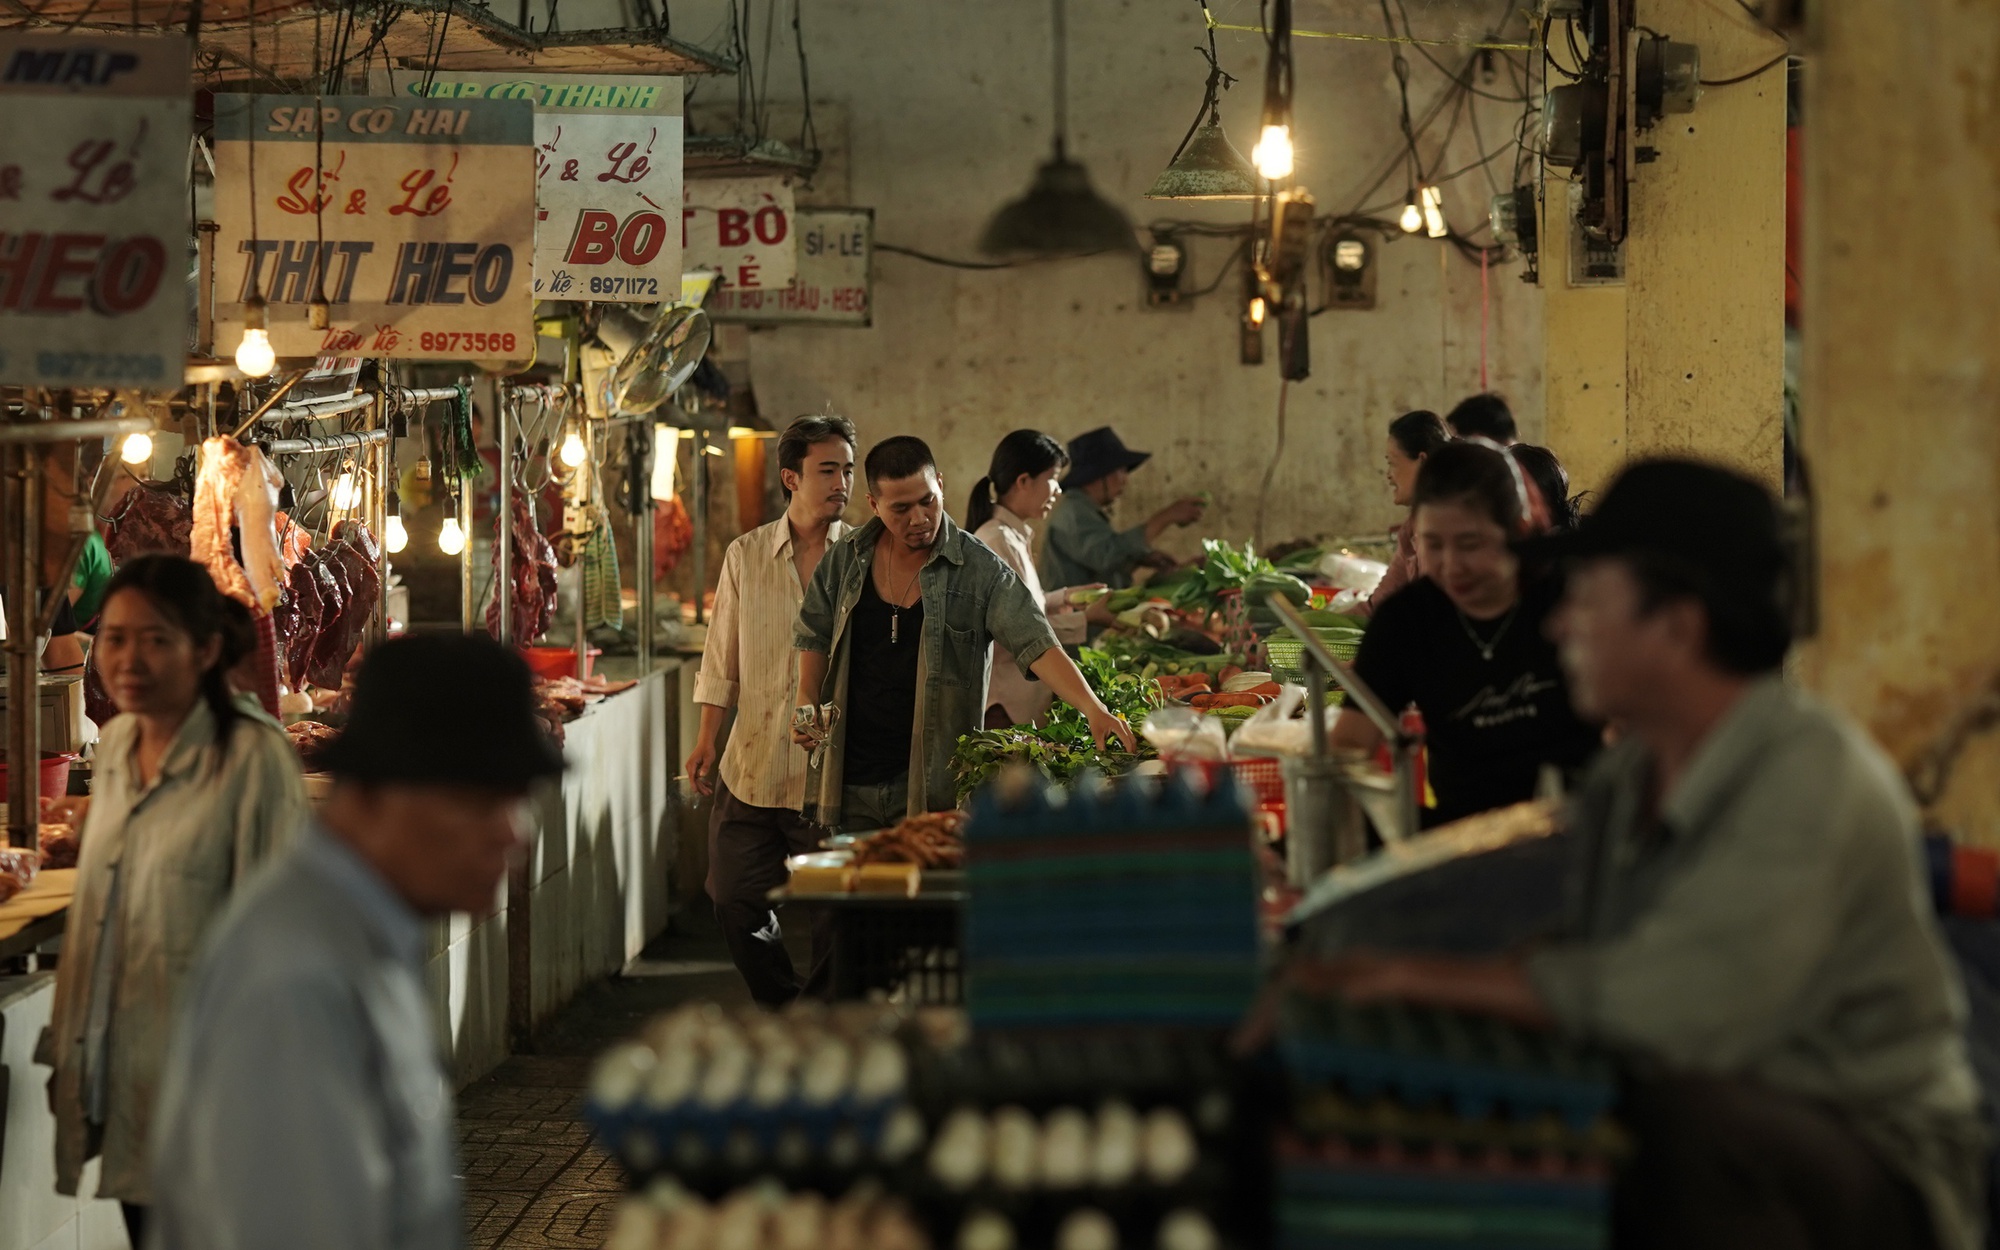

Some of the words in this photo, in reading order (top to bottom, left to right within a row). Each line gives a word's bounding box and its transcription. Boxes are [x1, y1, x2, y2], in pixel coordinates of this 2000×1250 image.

[268, 107, 341, 138] SẠP
[405, 109, 470, 135] HAI
[540, 85, 662, 108] THANH
[560, 158, 579, 181] &
[597, 127, 656, 184] Lẻ
[345, 188, 367, 215] &
[388, 152, 459, 217] Lẻ
[562, 191, 667, 265] BÒ
[719, 193, 788, 248] BÒ
[0, 231, 166, 316] HEO
[385, 242, 514, 306] HEO
[590, 276, 658, 295] 8971172
[420, 331, 516, 352] 8973568
